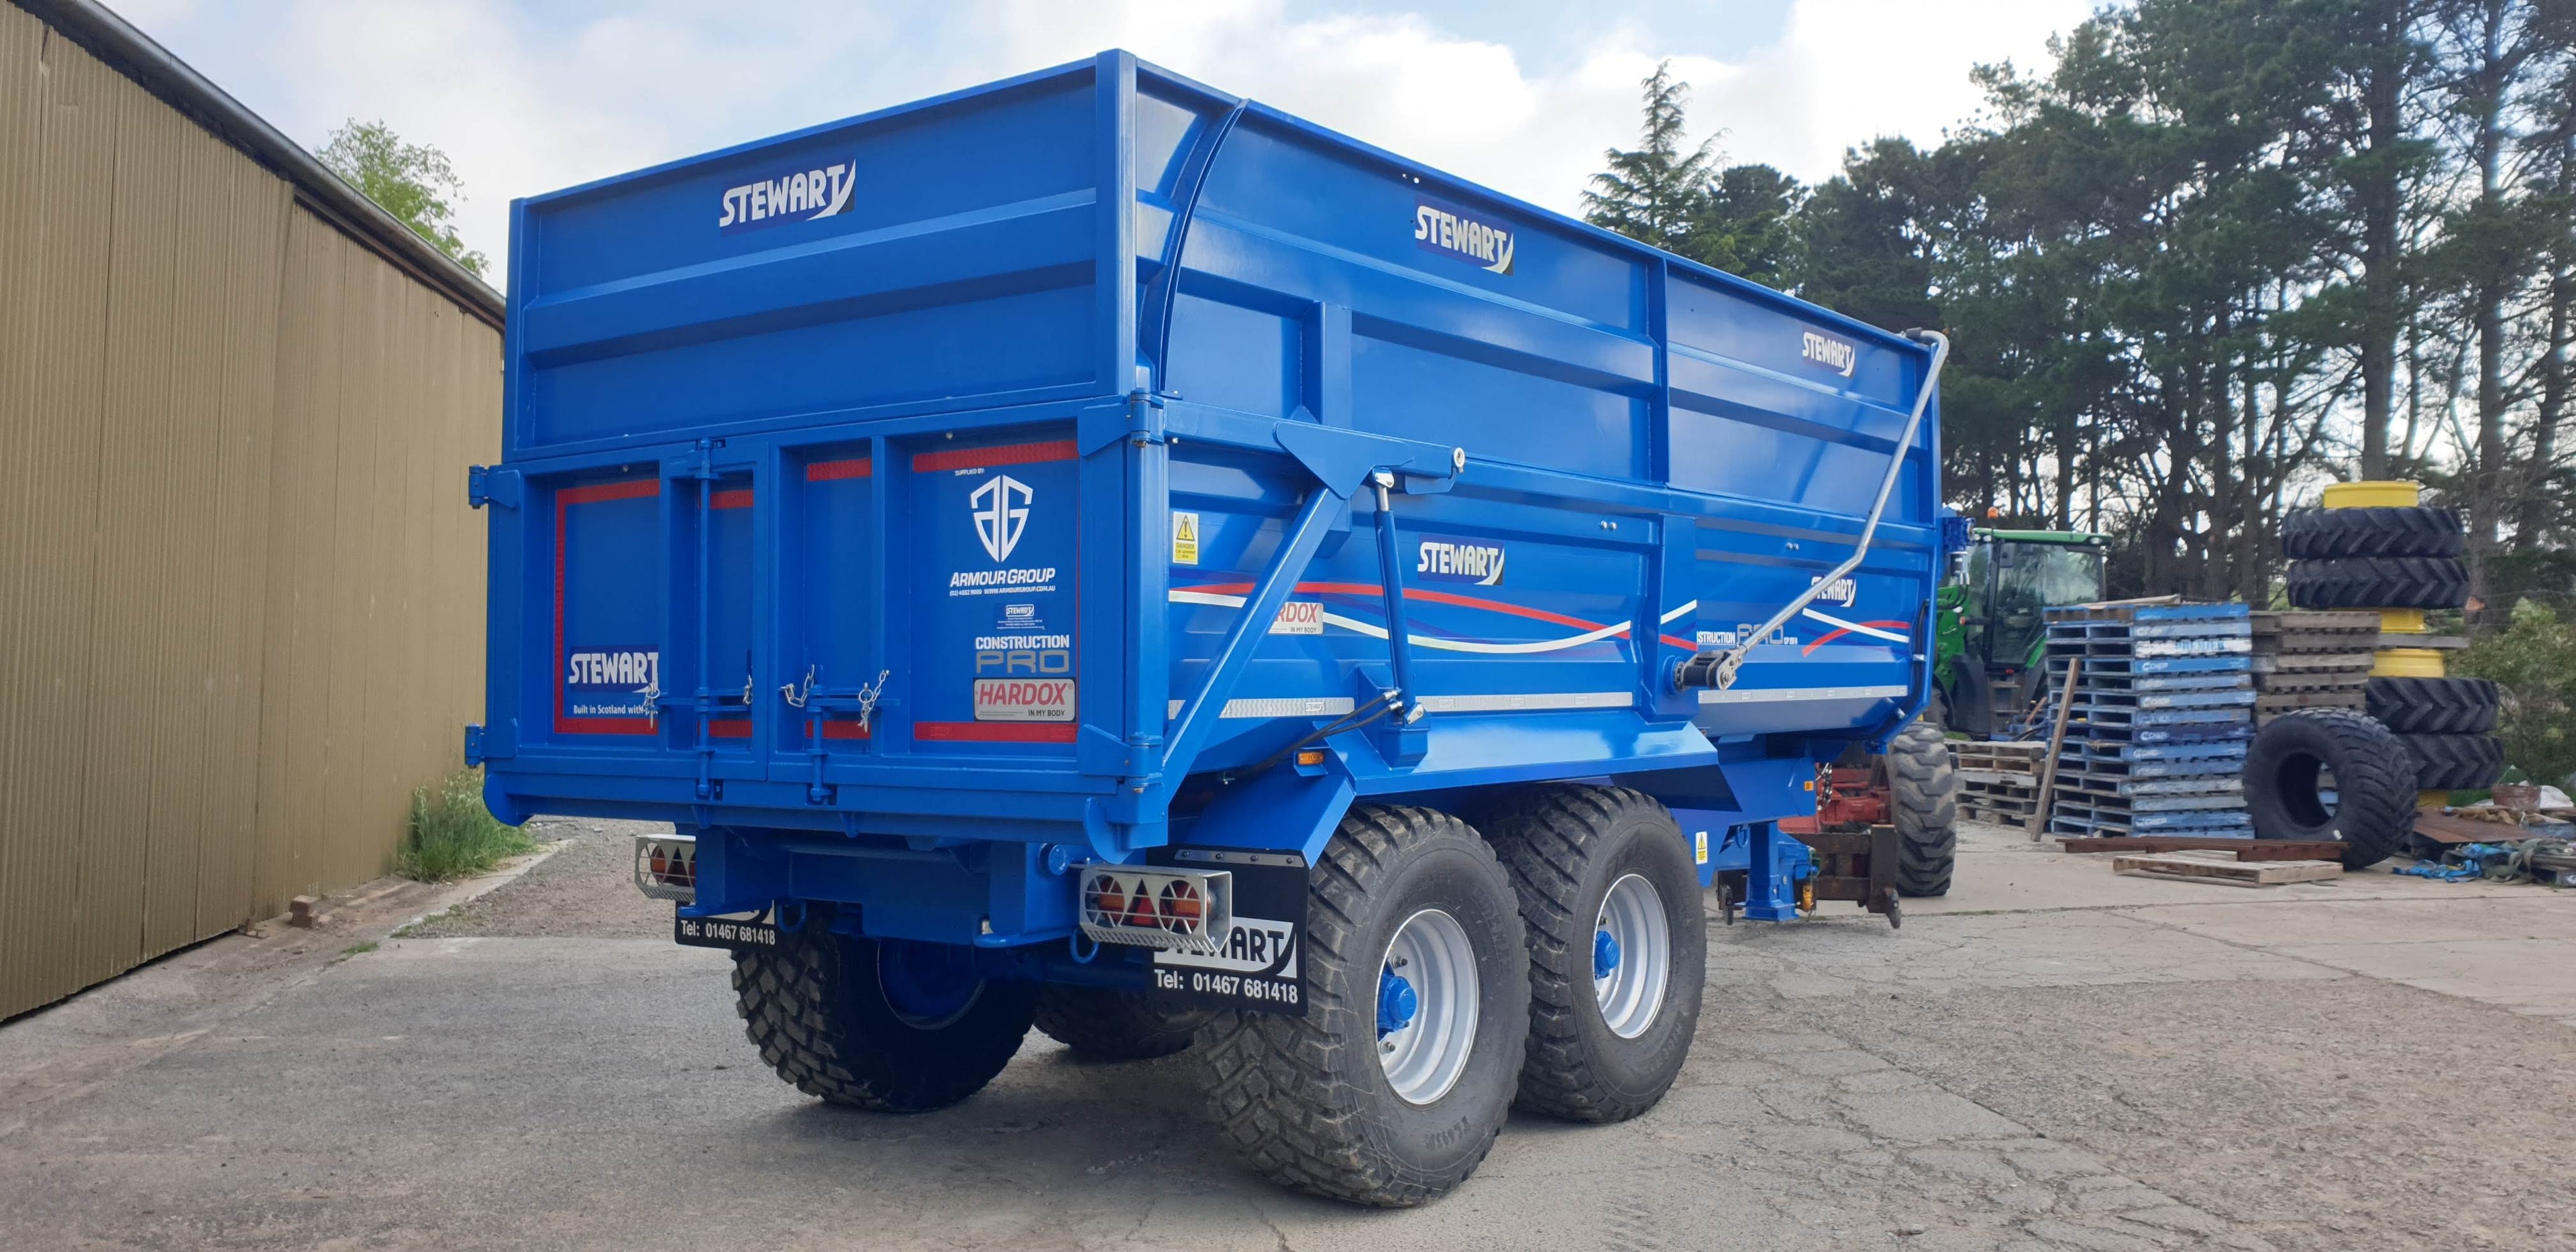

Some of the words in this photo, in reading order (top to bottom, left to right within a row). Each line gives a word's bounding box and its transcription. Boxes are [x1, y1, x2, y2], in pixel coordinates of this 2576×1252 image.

[719, 159, 856, 227] STEWART
[1415, 205, 1514, 274] STEWART
[1802, 331, 1856, 377] STEWART
[1417, 541, 1505, 585] STEWART
[950, 570, 1006, 587] ARMOUR
[1007, 567, 1056, 584] GROUP
[1007, 606, 1034, 616] STEWART
[975, 634, 1070, 649] CONSTRUCTION
[976, 650, 1069, 674] PRO
[574, 704, 588, 714] Built
[590, 704, 596, 714] in
[598, 704, 626, 714] Scotland
[627, 704, 643, 714] with
[1047, 709, 1066, 717] BODY
[680, 919, 700, 937] Tel:
[705, 922, 737, 940] 01467
[739, 925, 775, 946] 681418
[1154, 969, 1184, 990] Tel:
[1193, 972, 1240, 995] 01467
[1244, 978, 1299, 1004] 681418
